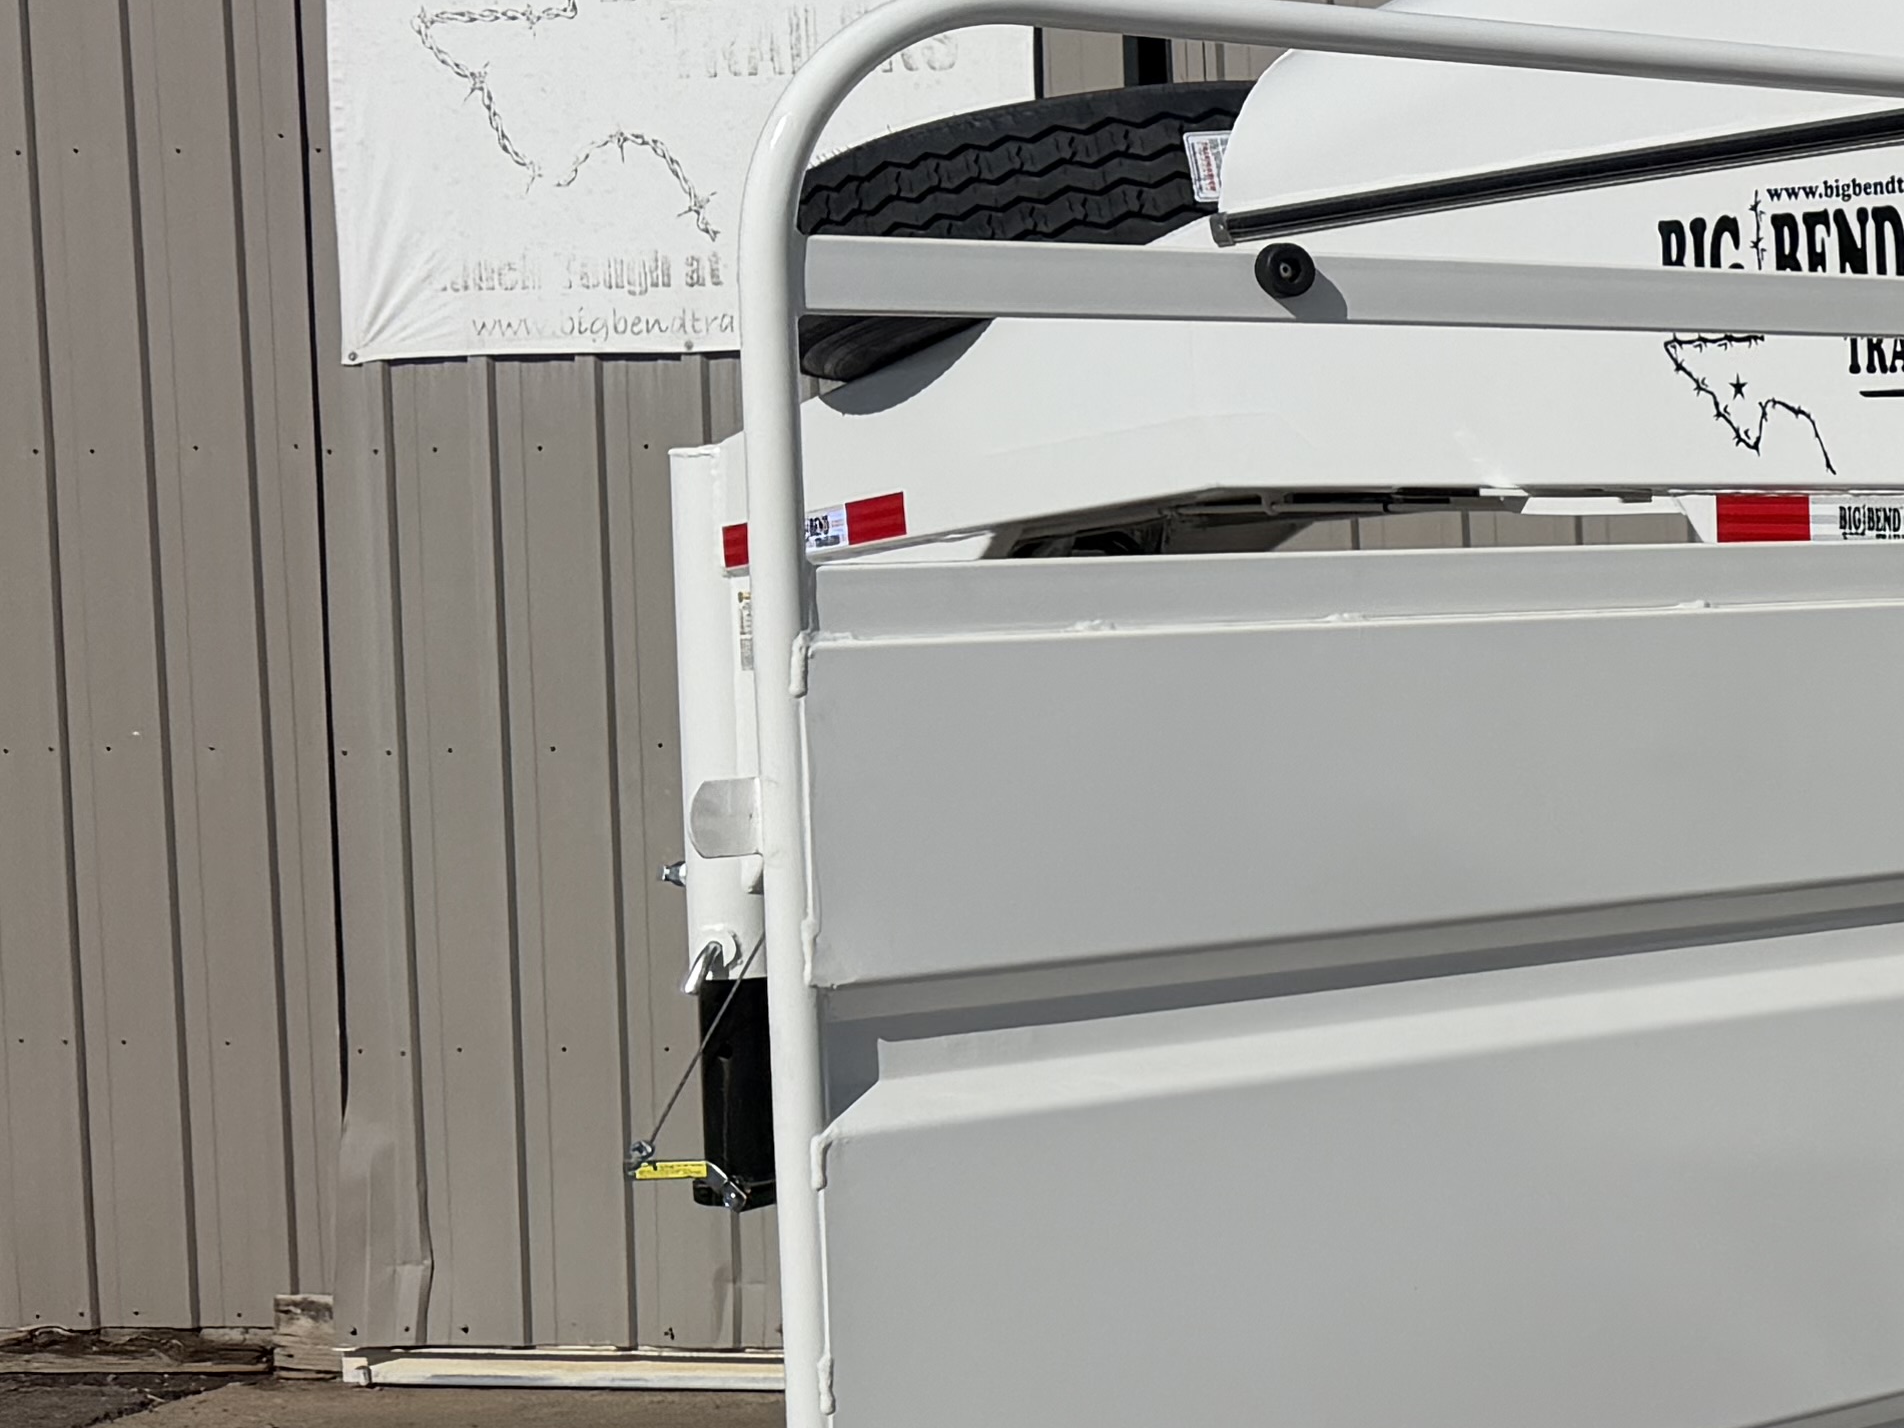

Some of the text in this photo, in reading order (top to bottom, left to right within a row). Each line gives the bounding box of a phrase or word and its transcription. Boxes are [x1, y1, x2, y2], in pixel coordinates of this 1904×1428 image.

[1657, 214, 1746, 270] BIG
[1839, 505, 1902, 533] BIG BEND
